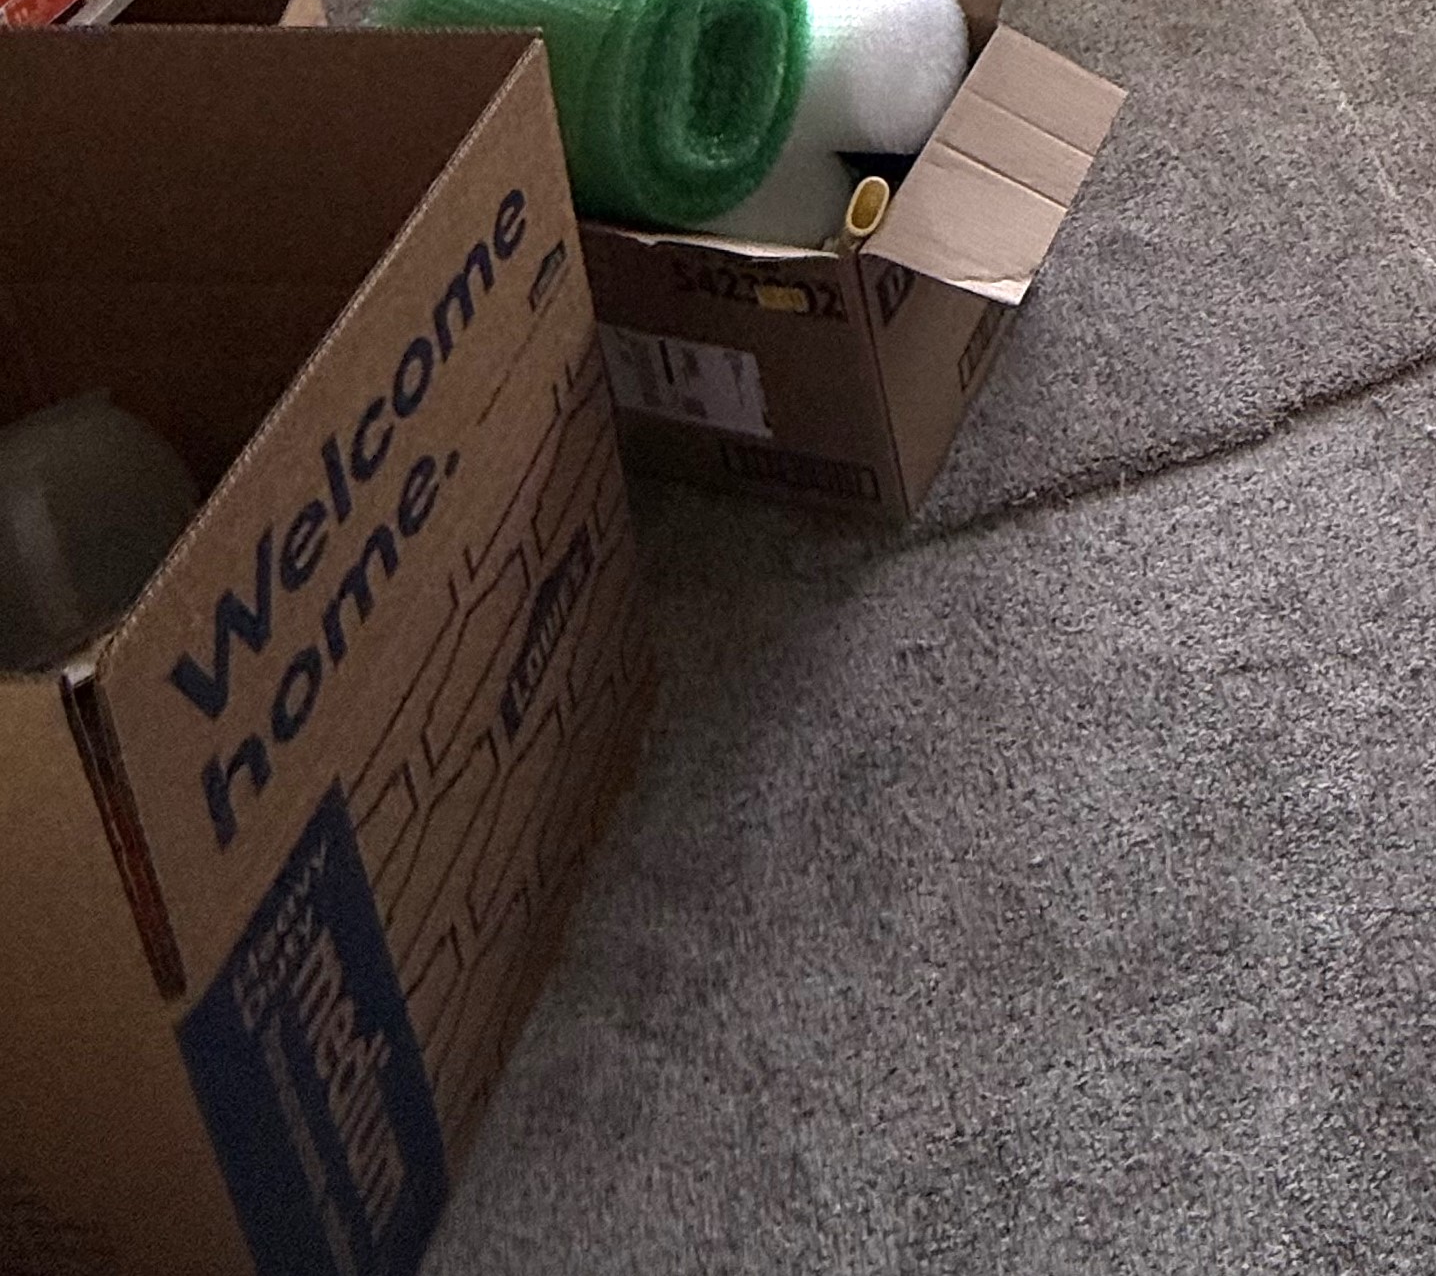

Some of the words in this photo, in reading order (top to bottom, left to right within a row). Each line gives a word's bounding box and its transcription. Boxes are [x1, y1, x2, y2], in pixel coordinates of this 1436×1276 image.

[168, 187, 528, 724] Welcome
[203, 447, 463, 850] home.
[293, 926, 408, 1240] medium
